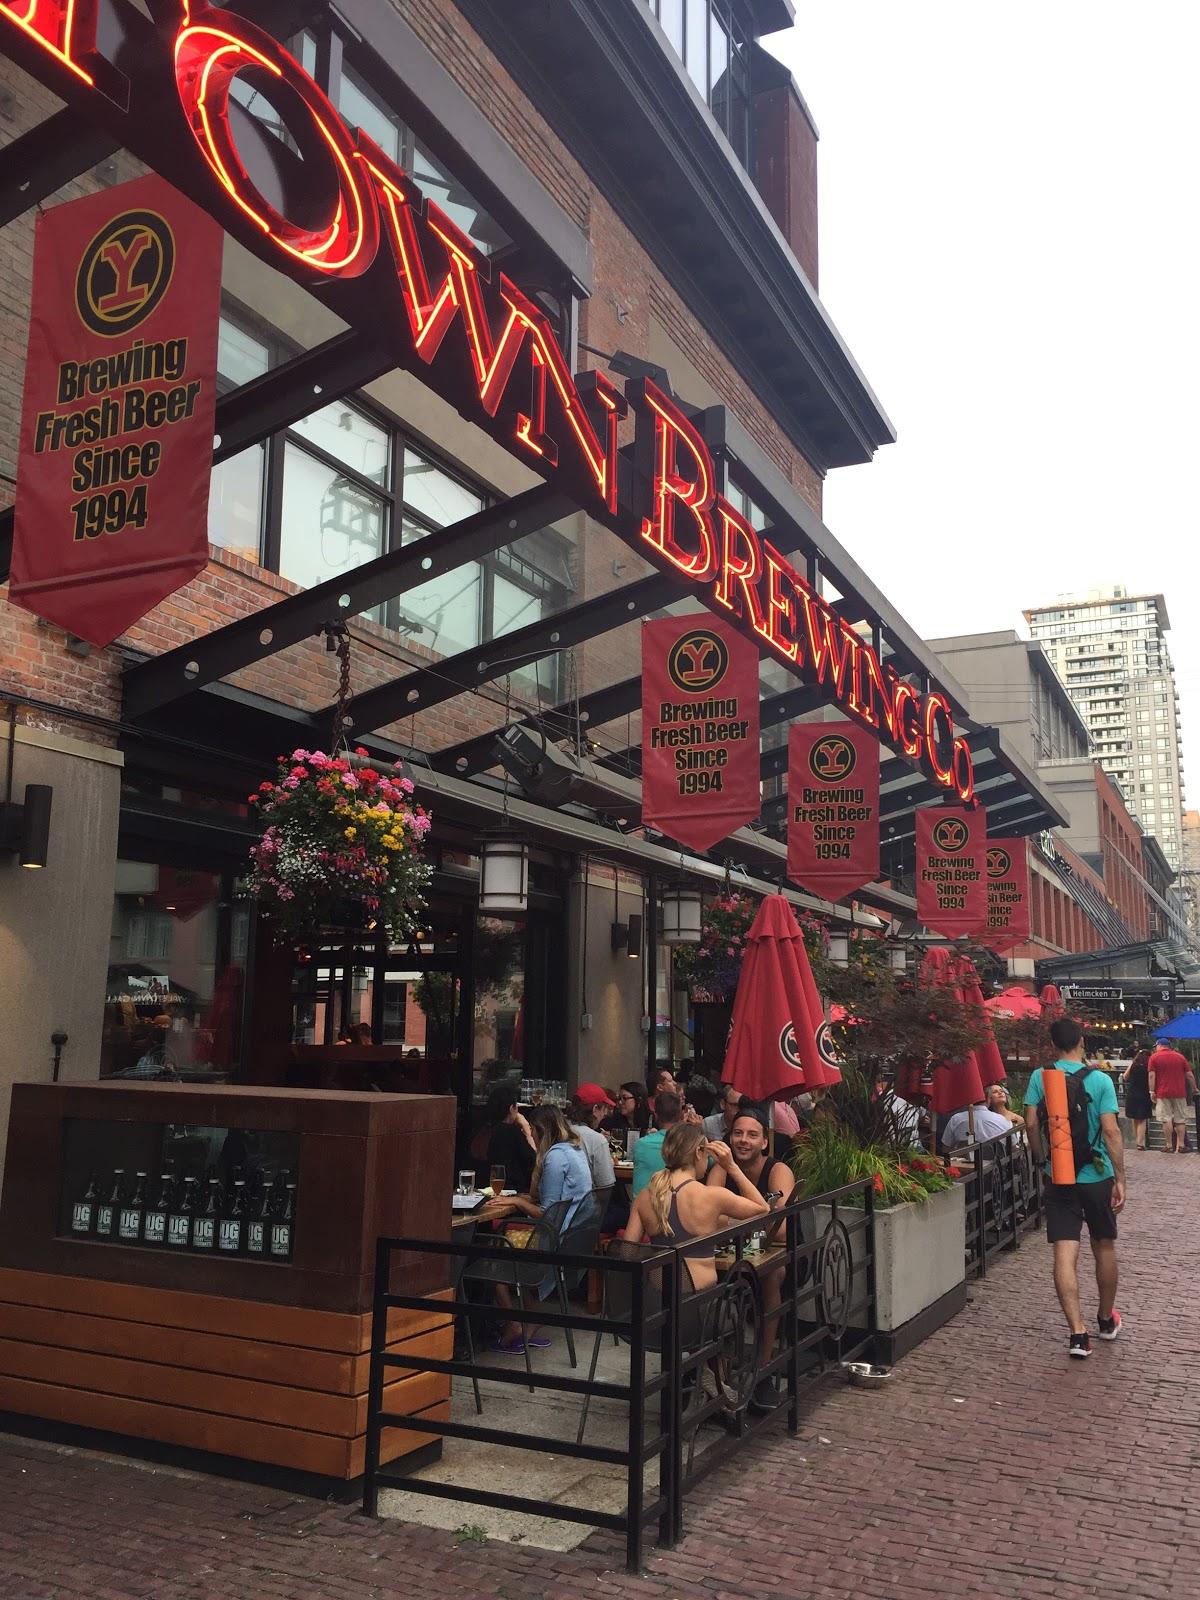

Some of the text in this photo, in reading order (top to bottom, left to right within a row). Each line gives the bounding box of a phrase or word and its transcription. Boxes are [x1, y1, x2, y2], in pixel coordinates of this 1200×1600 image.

[57, 337, 188, 405] Brewing
[34, 379, 201, 454] Fresh Beer
[72, 440, 161, 492] Since
[71, 484, 148, 542] 1994
[641, 377, 923, 759] BREWING
[660, 697, 737, 723] Brewing
[651, 720, 749, 748] Fresh Beer
[675, 747, 727, 770] Since
[677, 771, 722, 794] 1994
[802, 787, 864, 804] Brewing
[794, 805, 872, 823] Fresh Beer
[813, 824, 855, 841] Since
[815, 842, 851, 860] 1994
[928, 856, 974, 868] Brewing
[922, 869, 980, 881] Fresh Beer
[936, 883, 968, 895] Since
[987, 882, 1016, 892] ewing
[938, 897, 965, 909] 1994
[1000, 893, 1022, 903] Beer
[987, 905, 1012, 915] ince
